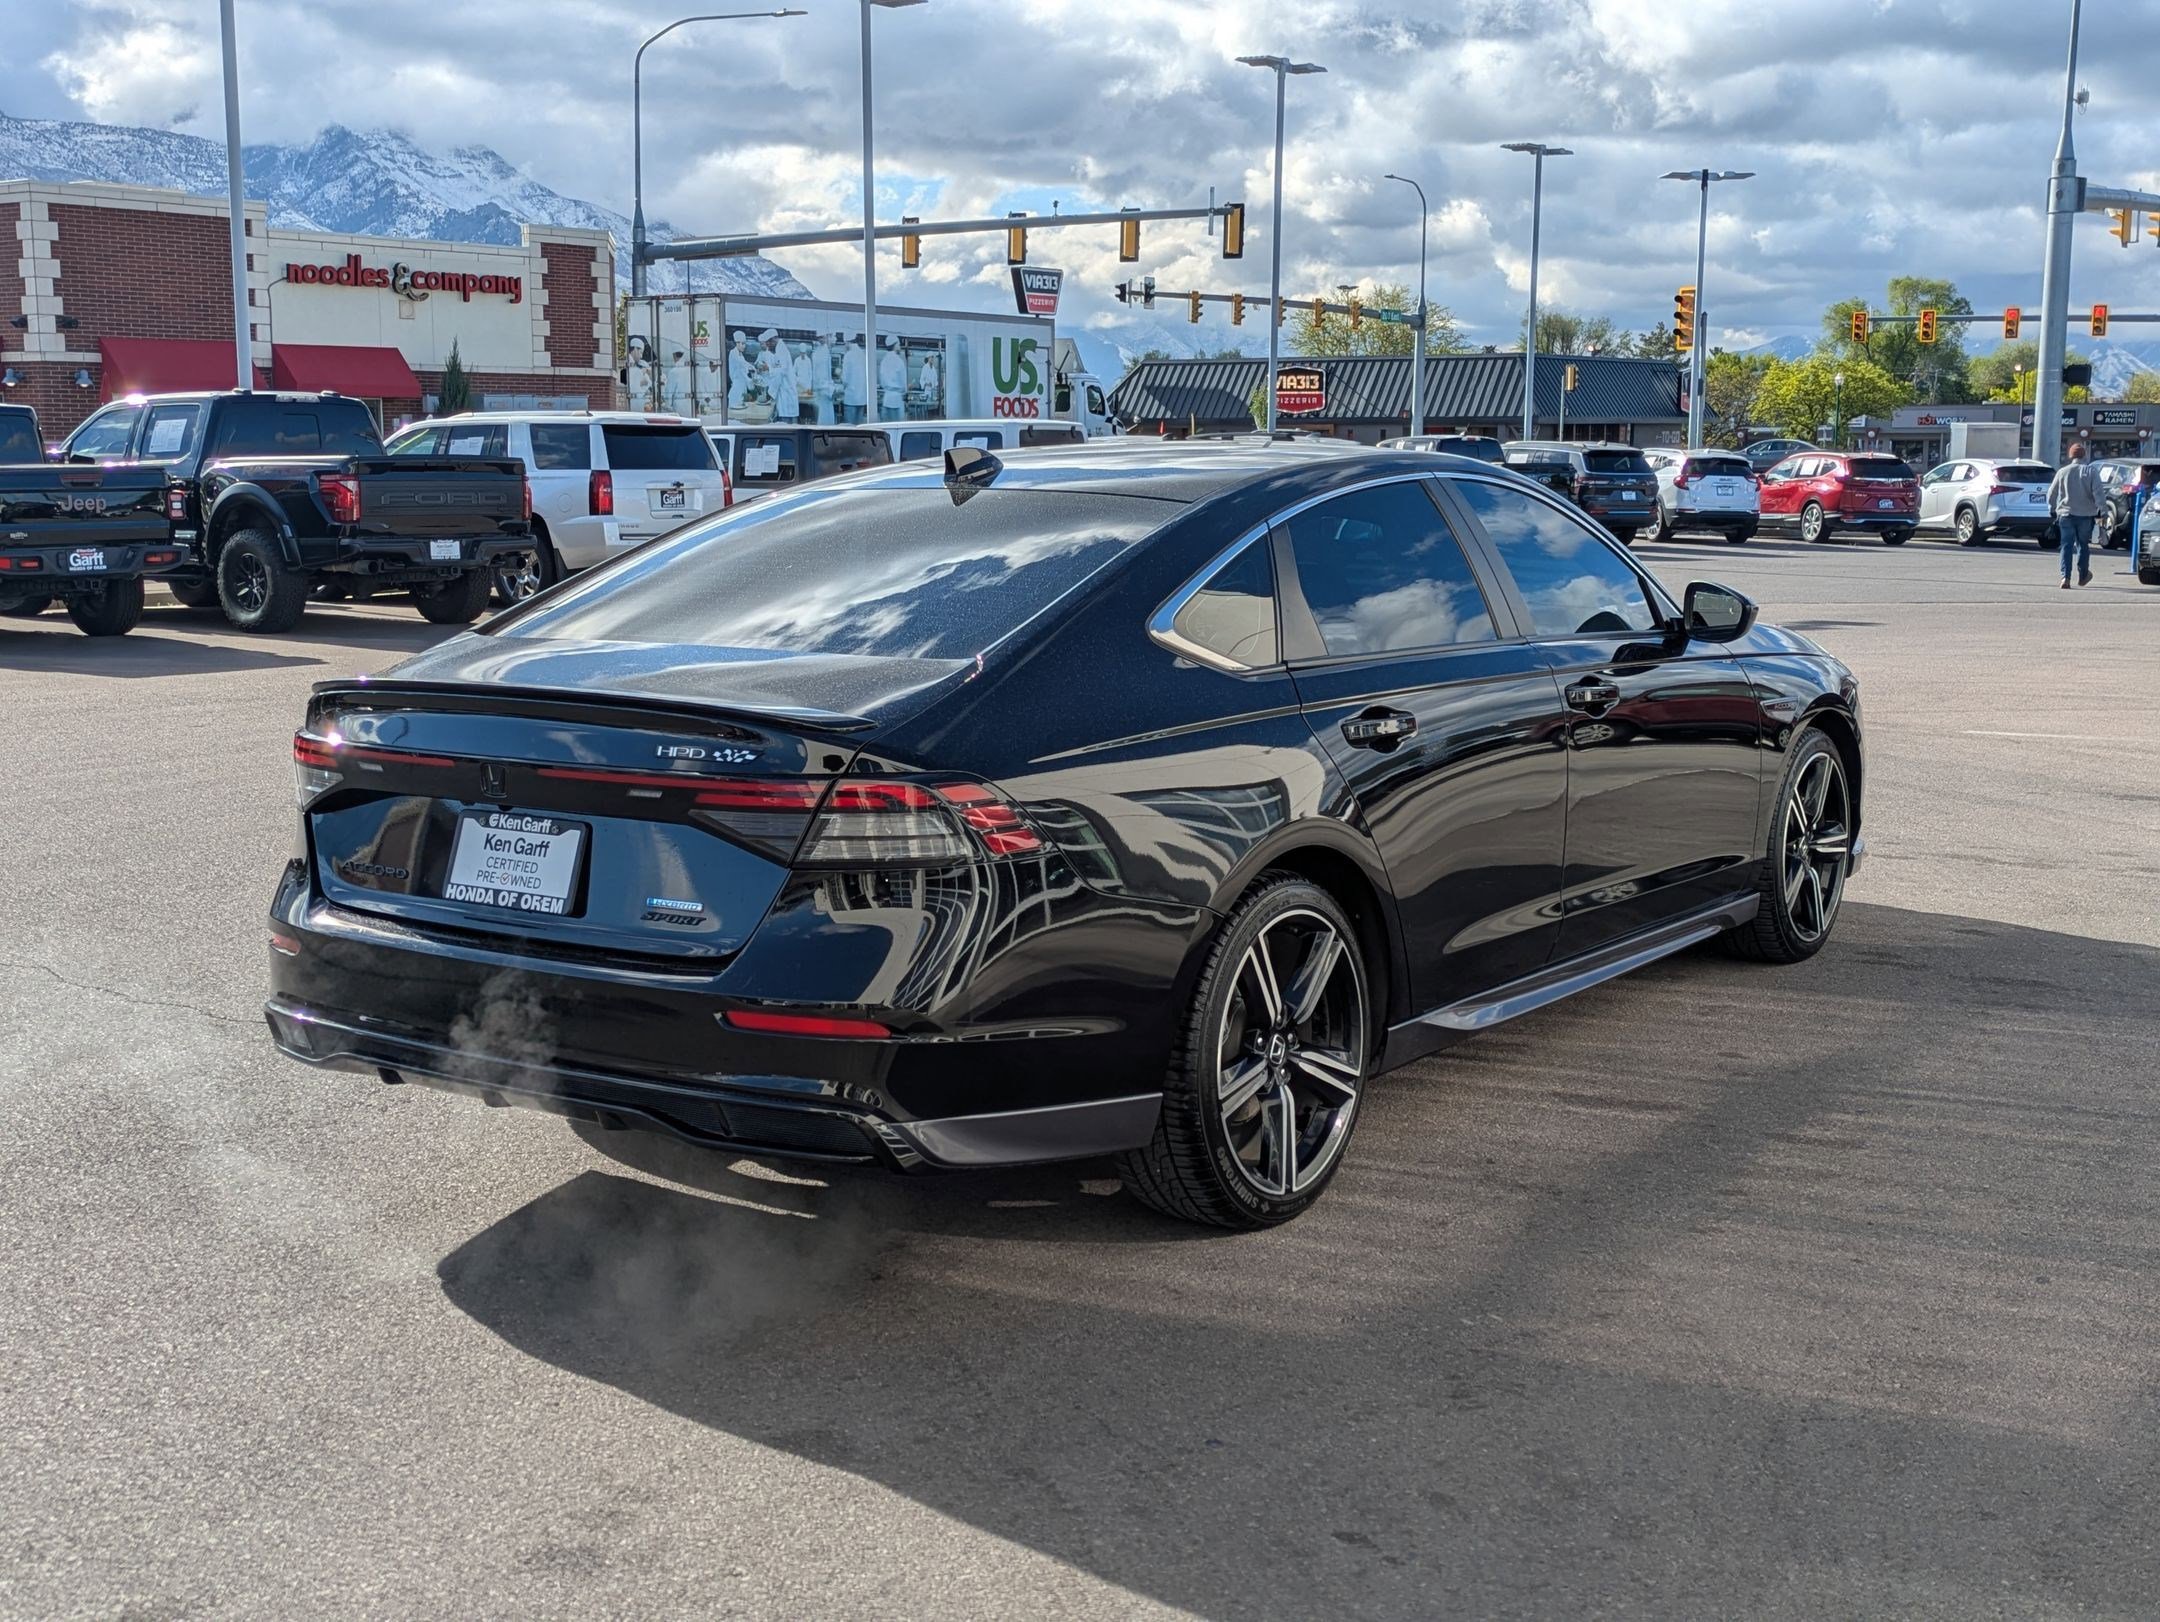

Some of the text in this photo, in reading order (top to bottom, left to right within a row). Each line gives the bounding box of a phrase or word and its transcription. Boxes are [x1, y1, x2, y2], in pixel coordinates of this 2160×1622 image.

[287, 253, 522, 304] noodles & company
[1025, 274, 1059, 290] VIA313
[1028, 299, 1055, 307] PIZZERIA
[994, 397, 1039, 417] FOODS
[61, 495, 107, 513] Jeep
[381, 492, 508, 505] FORD
[70, 552, 104, 567] Garff
[657, 746, 706, 759] HPD
[499, 814, 552, 834] Ken Garff
[484, 833, 550, 858] Ken Garff
[343, 861, 409, 879] ACCORD
[486, 856, 539, 874] CERTIFIED
[446, 884, 564, 915] HONDA OF OREM
[640, 911, 706, 926] SPORT
[1217, 1146, 1259, 1209] SUMITOMO
